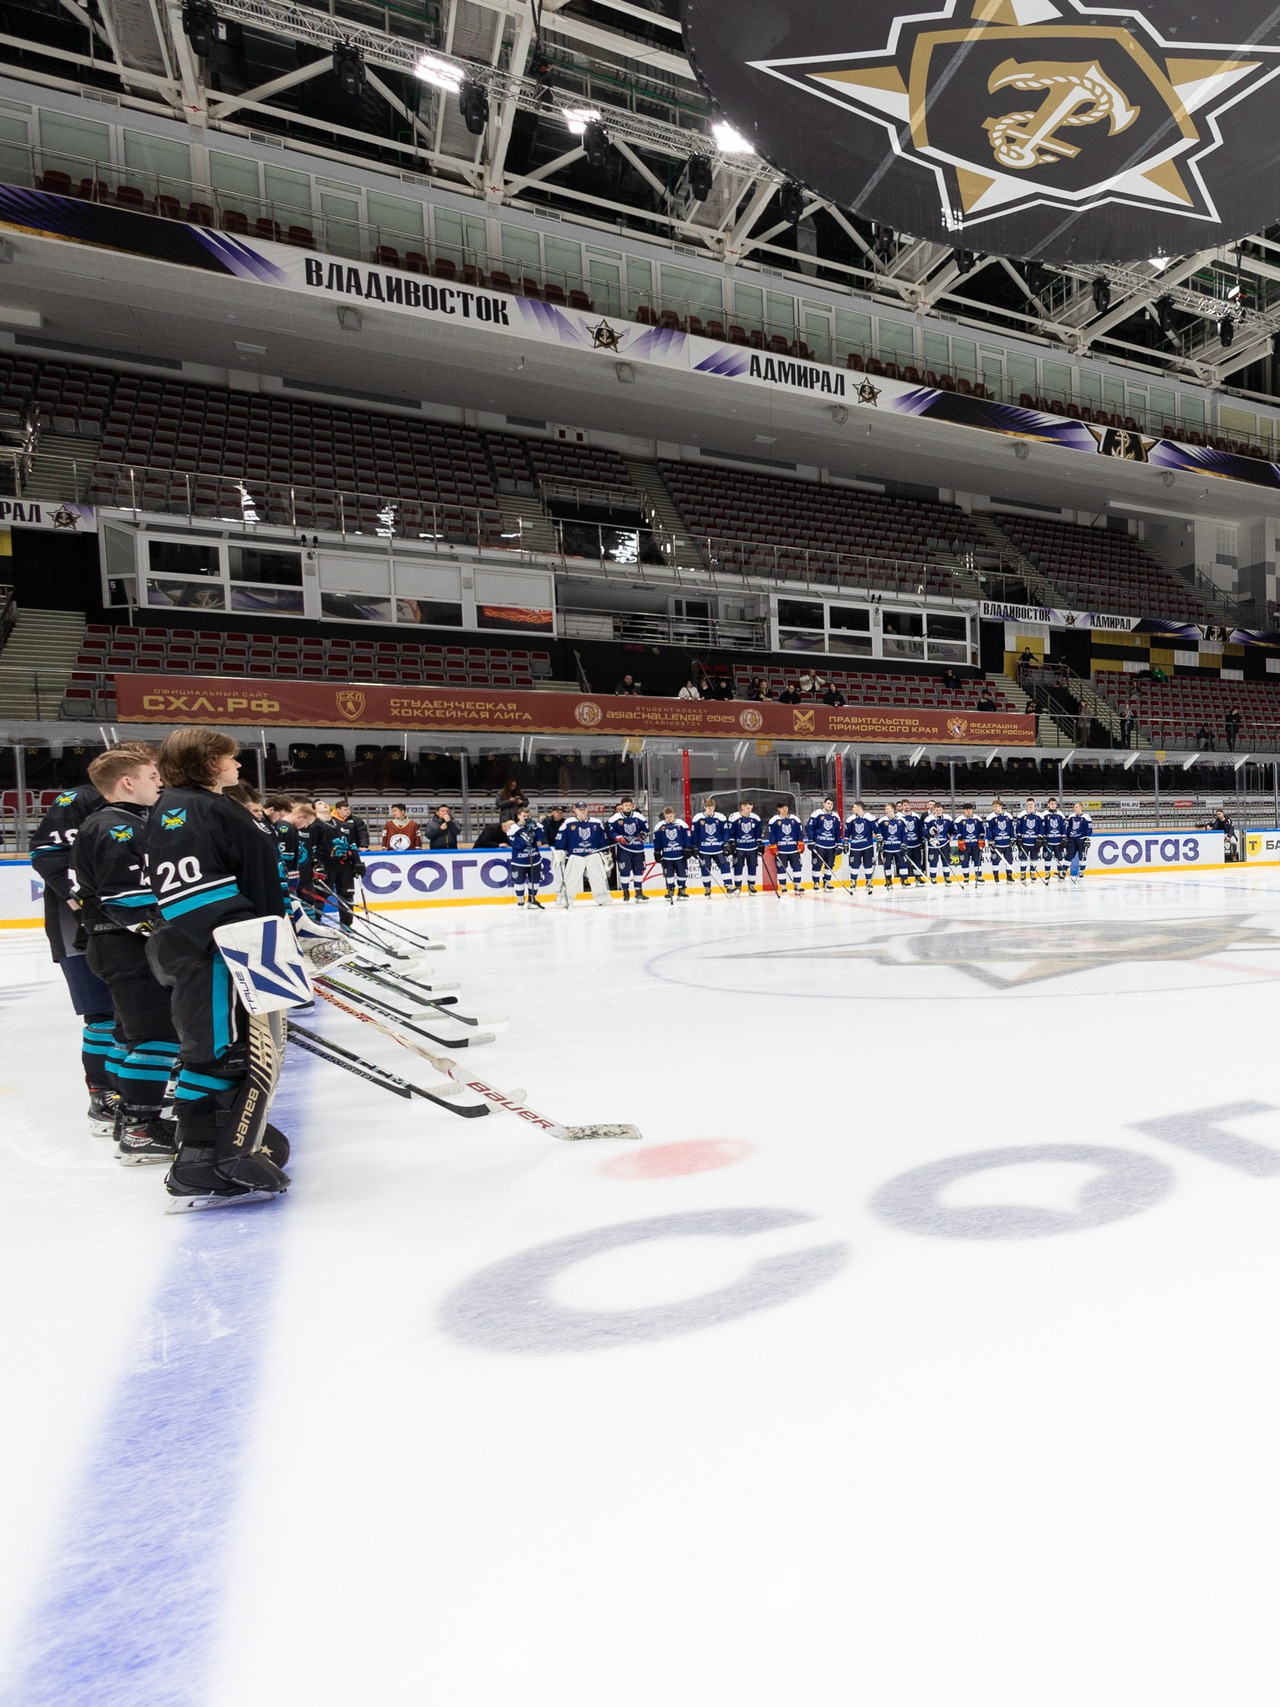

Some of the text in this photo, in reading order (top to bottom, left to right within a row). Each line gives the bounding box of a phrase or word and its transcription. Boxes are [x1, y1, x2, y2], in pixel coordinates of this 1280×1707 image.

[304, 257, 510, 326] ВЛАДИВОСТОК
[749, 354, 845, 397] АДМИРАЛ
[983, 602, 1051, 622] ВЛАДИВОСТОК
[1089, 614, 1132, 630] АДМИРАЛ
[153, 688, 240, 698] ОФИЦИАЛЬНЫЙ
[142, 695, 280, 713] СХЛ.РФ
[390, 699, 517, 711] СТУДЕНЧЕСКАЯ
[390, 708, 533, 720] ХОККЕЙНАЯ ЛИГА
[828, 715, 920, 726] ПРАВИТЕЛЬСТВО
[643, 719, 702, 727] VLADIVOSTOK
[828, 724, 939, 734] ПРИМОРСКОГО КРАЯ
[969, 722, 1018, 730] ФЕДЕРАЦИЯ
[156, 855, 203, 894] 20
[235, 970, 258, 1014] TRUE
